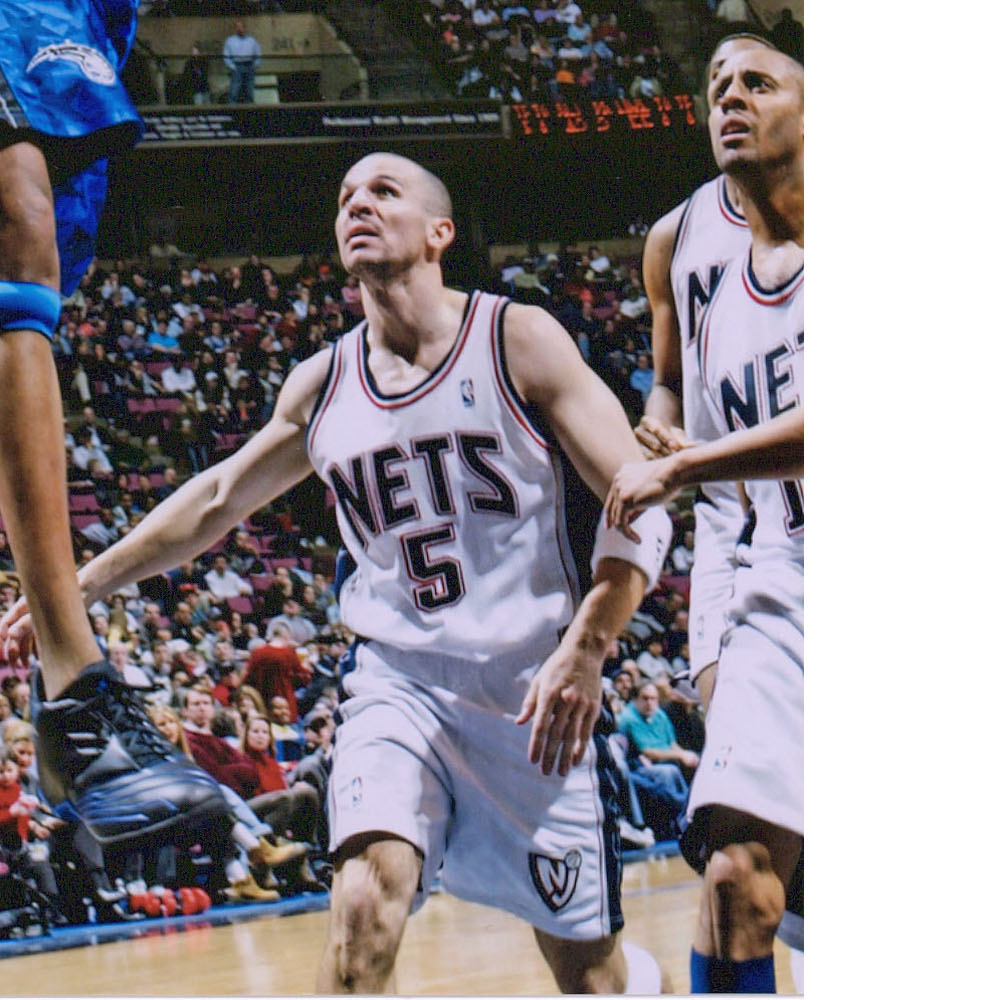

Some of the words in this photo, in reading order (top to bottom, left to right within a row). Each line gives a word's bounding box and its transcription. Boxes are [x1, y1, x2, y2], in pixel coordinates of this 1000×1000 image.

[719, 331, 804, 433] NE
[327, 430, 520, 552] NETS
[401, 522, 466, 613] 5
